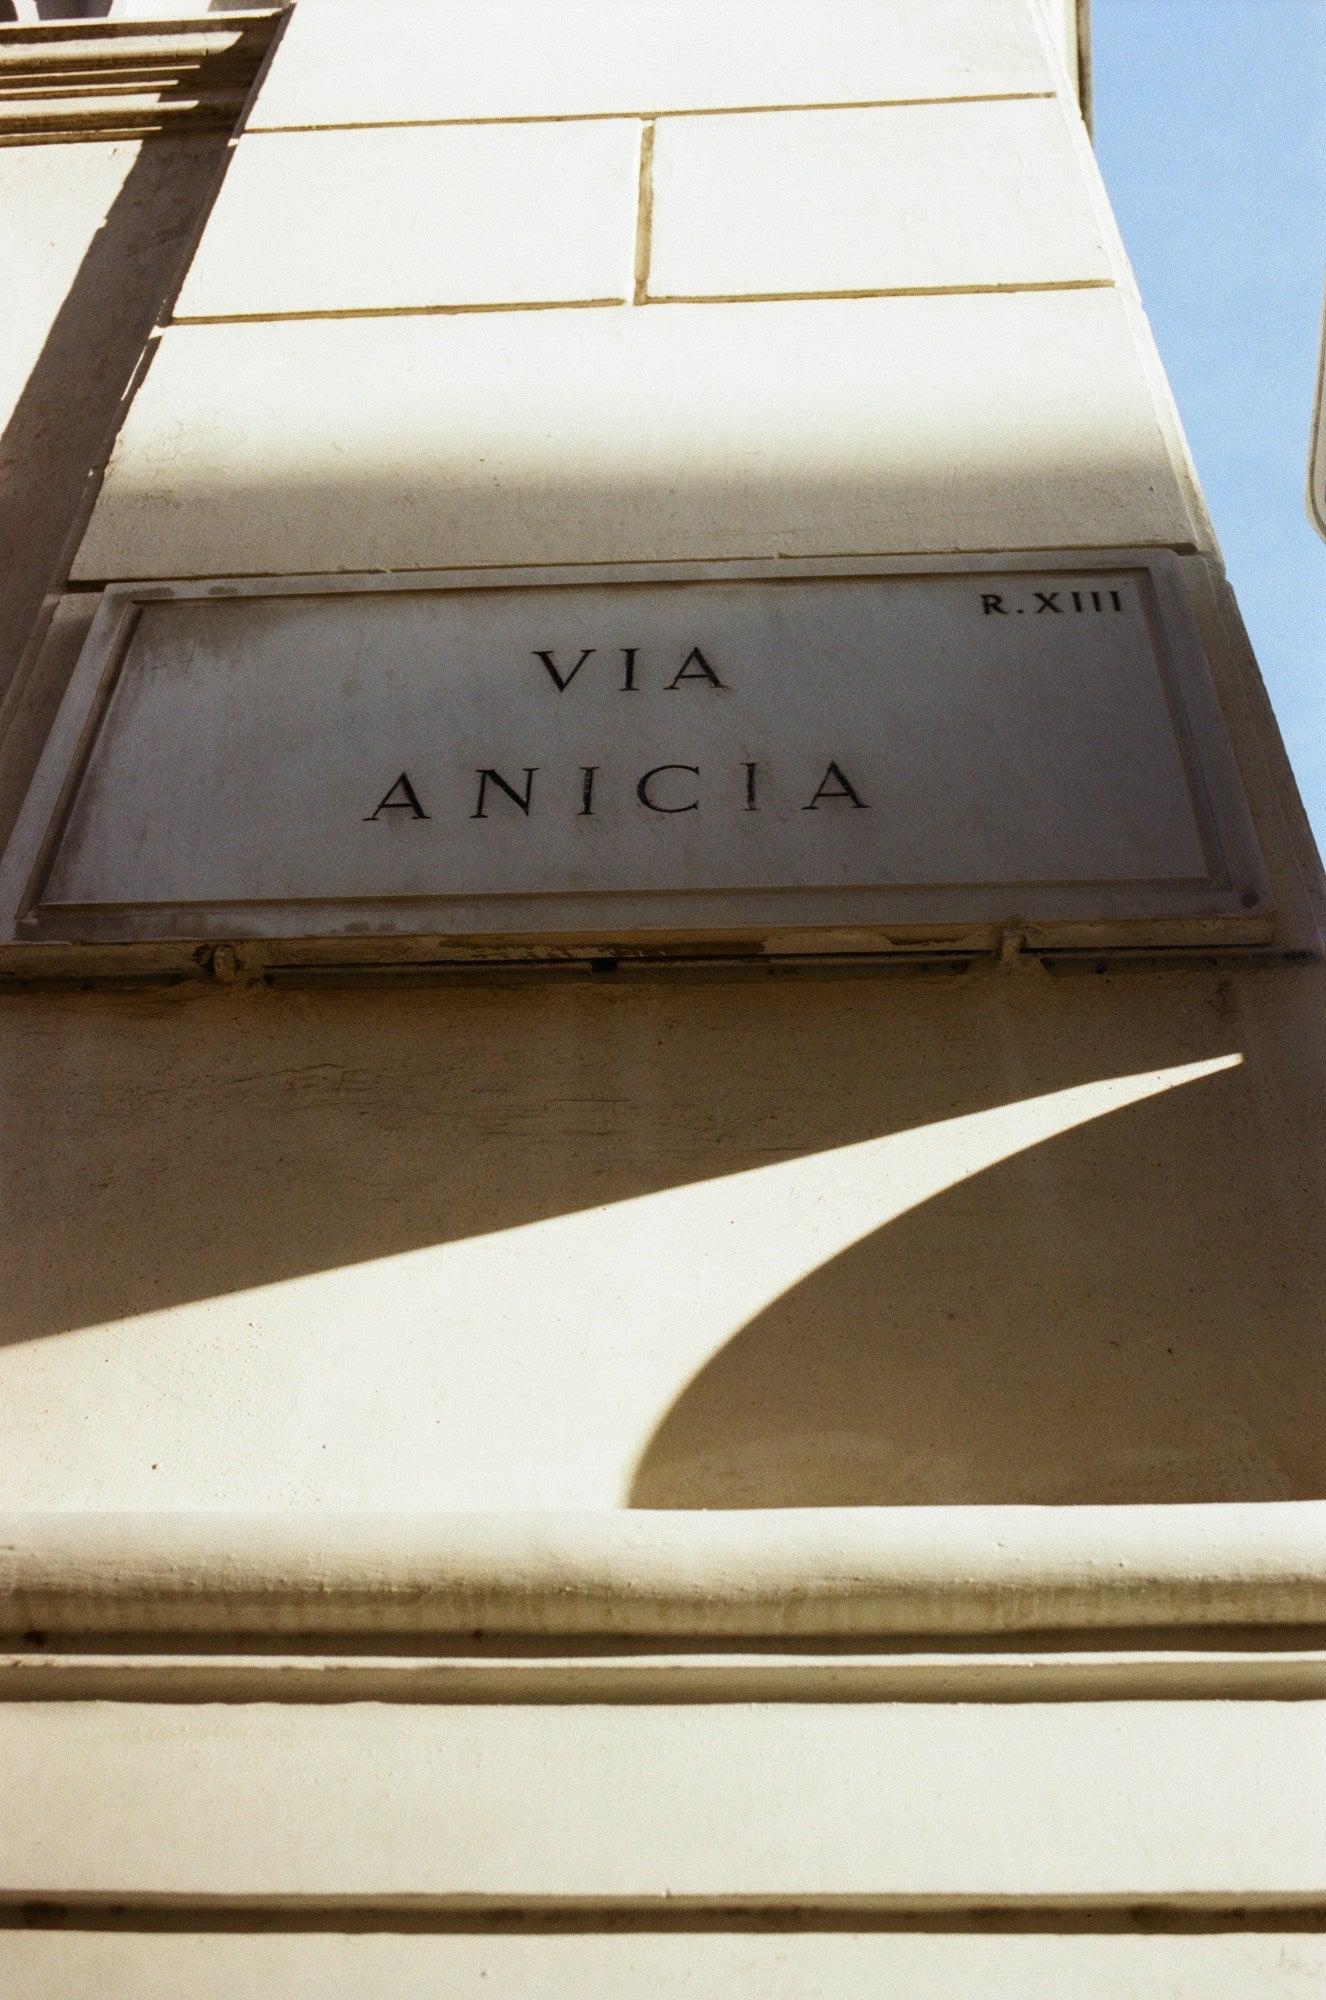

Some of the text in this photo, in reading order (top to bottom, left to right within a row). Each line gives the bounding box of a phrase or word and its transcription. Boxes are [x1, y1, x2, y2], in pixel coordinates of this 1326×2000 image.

[980, 590, 1122, 615] R.XIII
[531, 646, 731, 693] VIA
[362, 760, 871, 822] ANICIA
